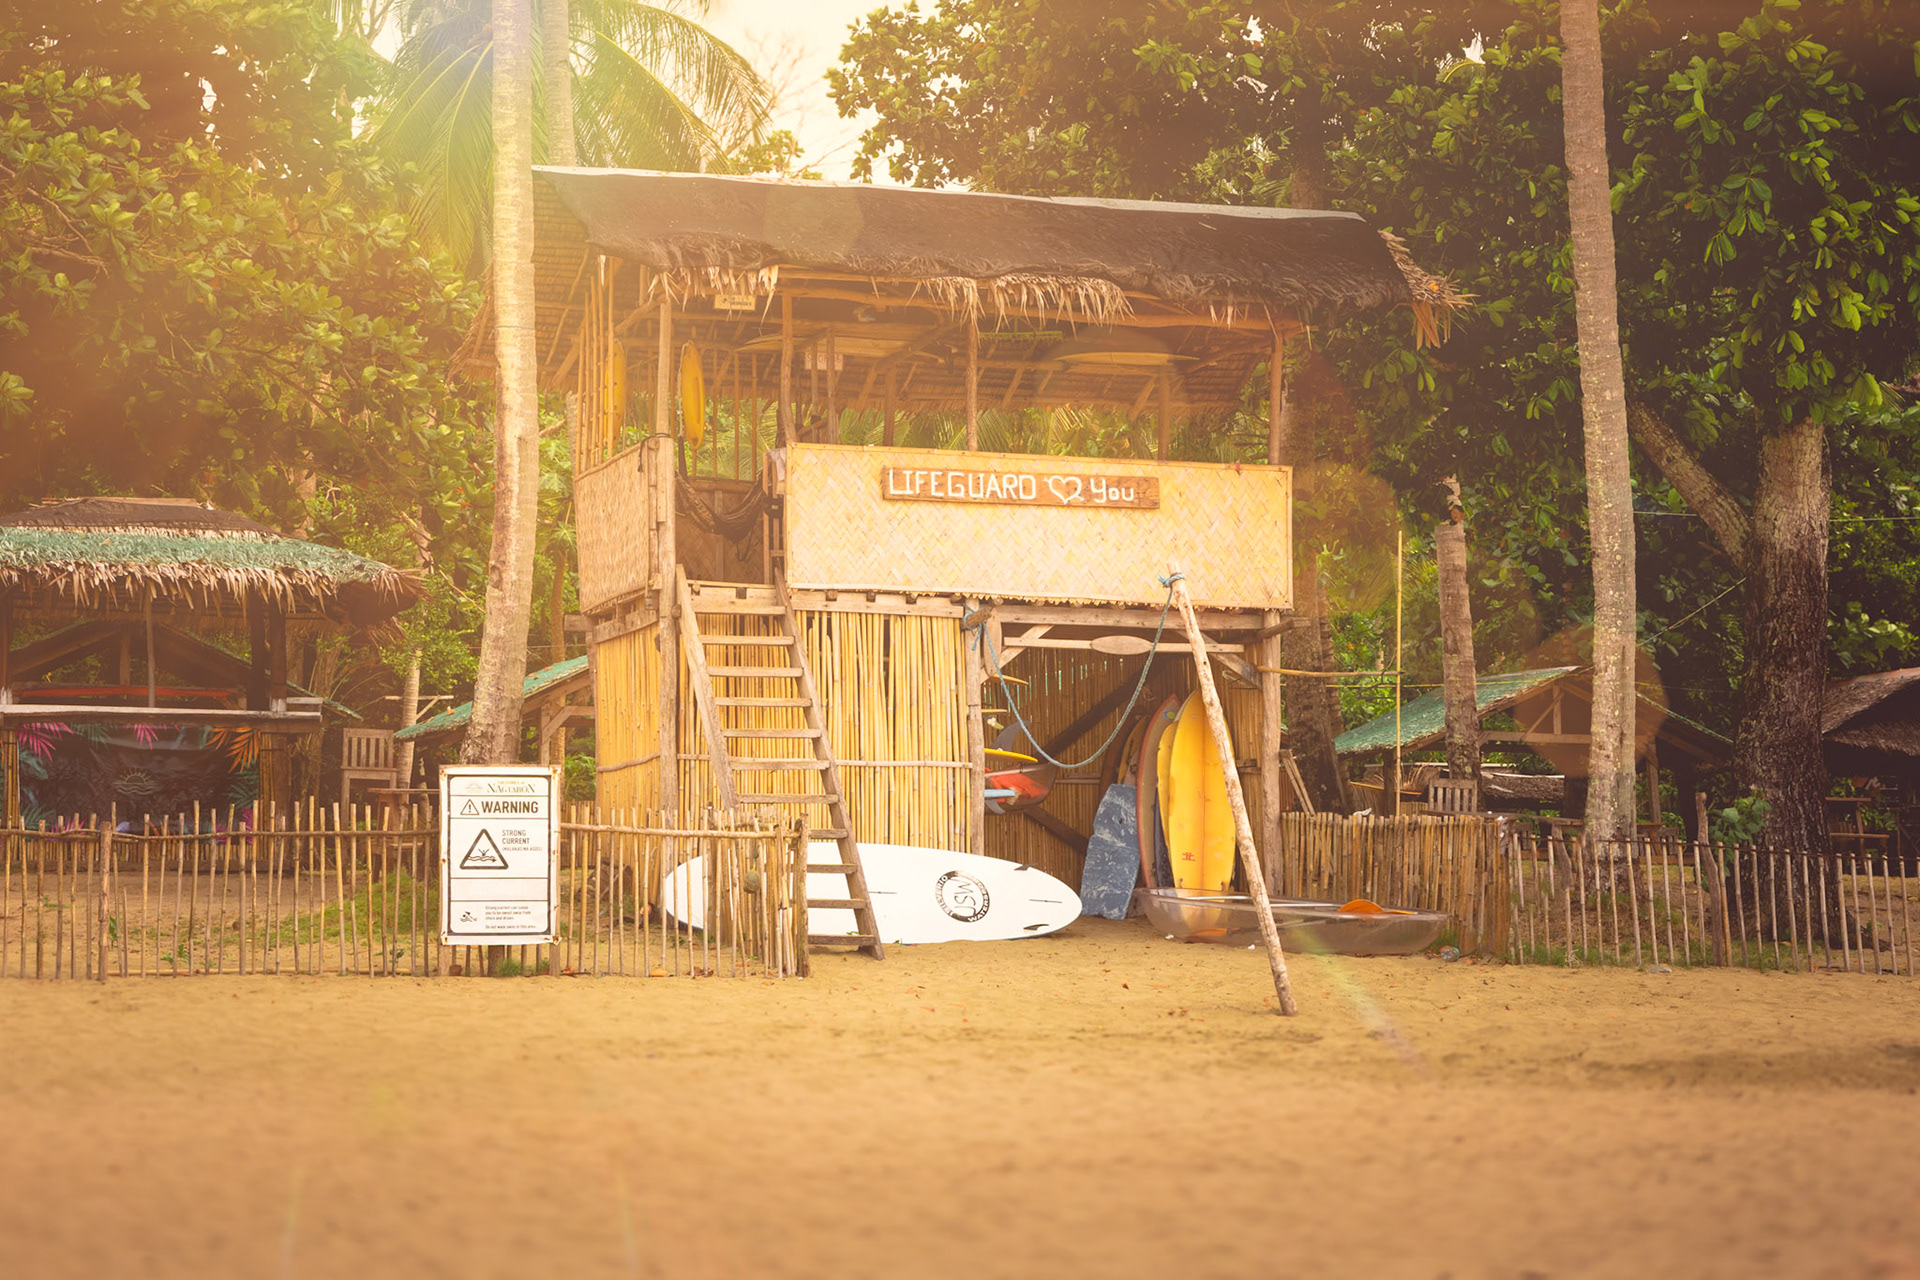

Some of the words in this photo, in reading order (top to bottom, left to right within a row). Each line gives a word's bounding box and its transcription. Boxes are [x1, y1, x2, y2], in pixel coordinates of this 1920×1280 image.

[888, 469, 1036, 500] LIFEGUARD
[1090, 478, 1135, 503] You
[481, 801, 539, 813] WARNING
